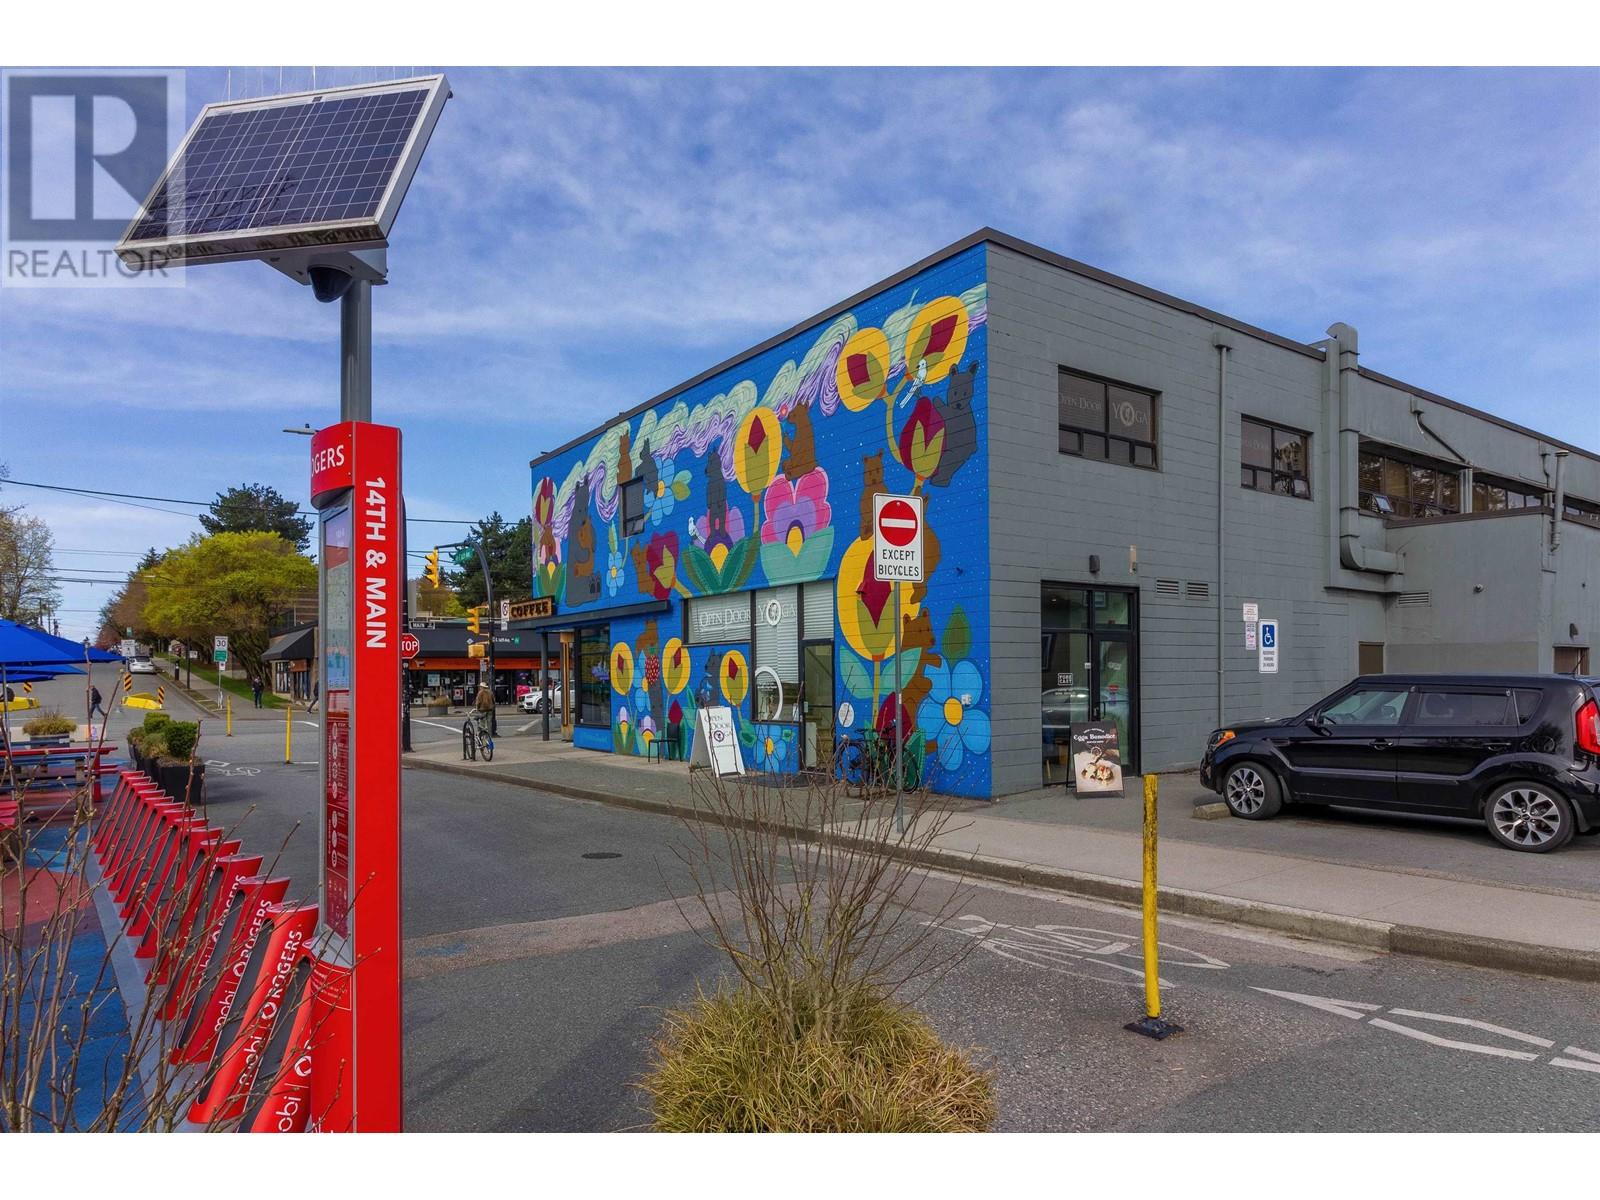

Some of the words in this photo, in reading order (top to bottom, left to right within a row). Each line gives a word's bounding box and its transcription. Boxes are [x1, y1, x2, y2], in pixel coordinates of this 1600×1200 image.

[1112, 401, 1148, 426] YOGA
[311, 444, 345, 478] GERS
[365, 476, 386, 541] 14TH
[365, 549, 387, 569] &
[882, 548, 915, 561] EXCEPT
[878, 564, 920, 577] BICYCLES
[366, 577, 387, 648] MAIN
[511, 601, 549, 618] COFFEE
[758, 599, 797, 626] YOGA
[216, 640, 227, 648] 30
[401, 640, 418, 651] TOP
[268, 930, 303, 999] ROGERS
[276, 1095, 302, 1132] obi
